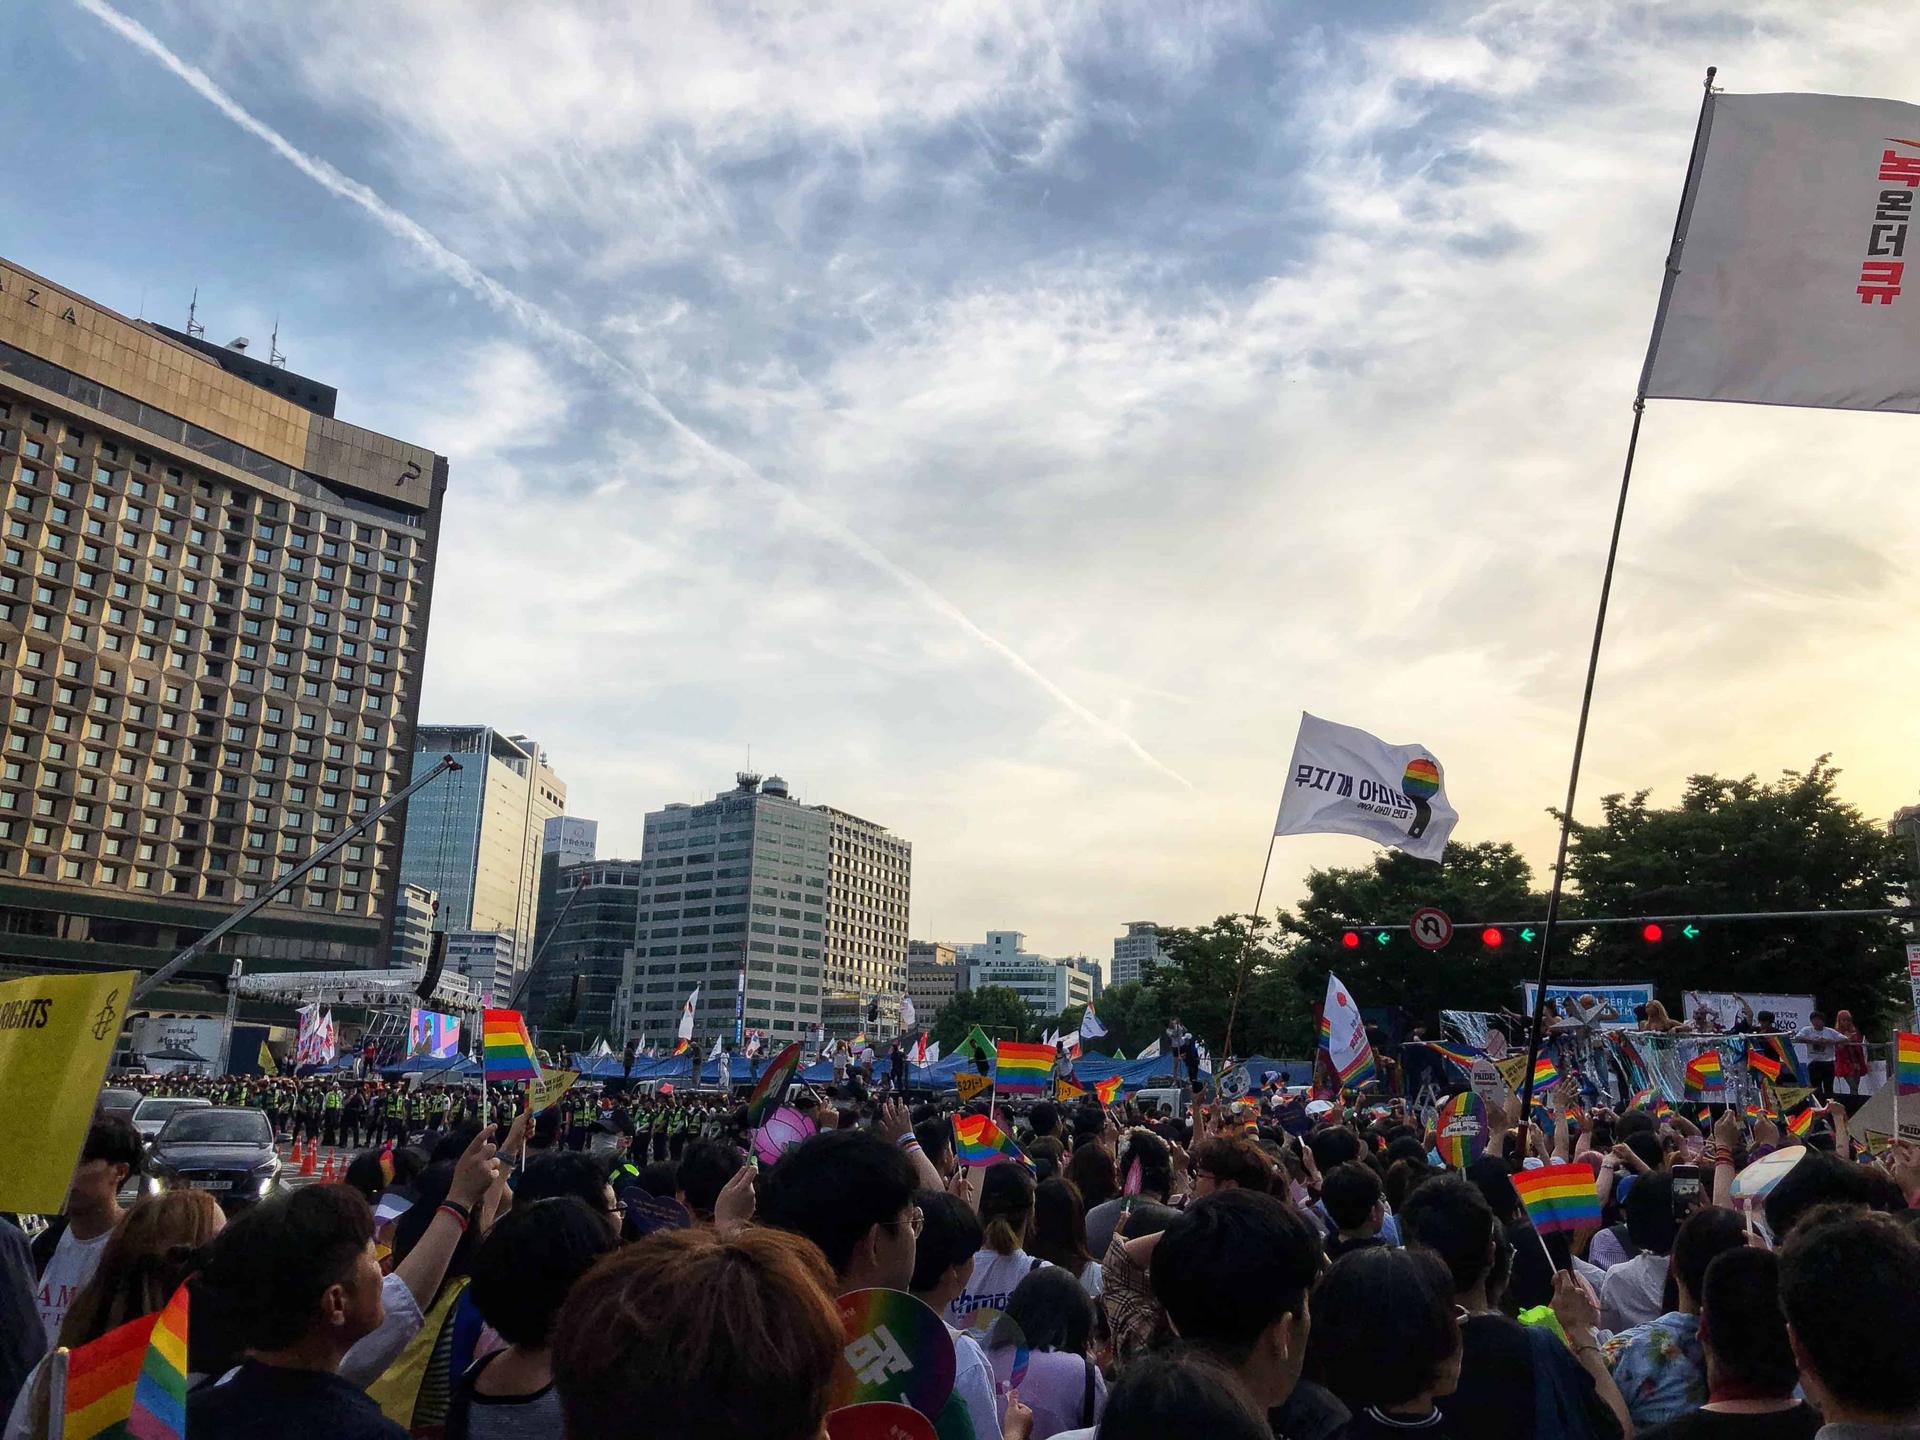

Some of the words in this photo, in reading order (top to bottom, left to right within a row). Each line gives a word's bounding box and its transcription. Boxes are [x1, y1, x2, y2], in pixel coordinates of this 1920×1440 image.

[0, 277, 76, 325] ZA
[1295, 764, 1353, 797] 무지개
[1374, 805, 1392, 816] 아미
[1770, 1020, 1797, 1030] OKYO
